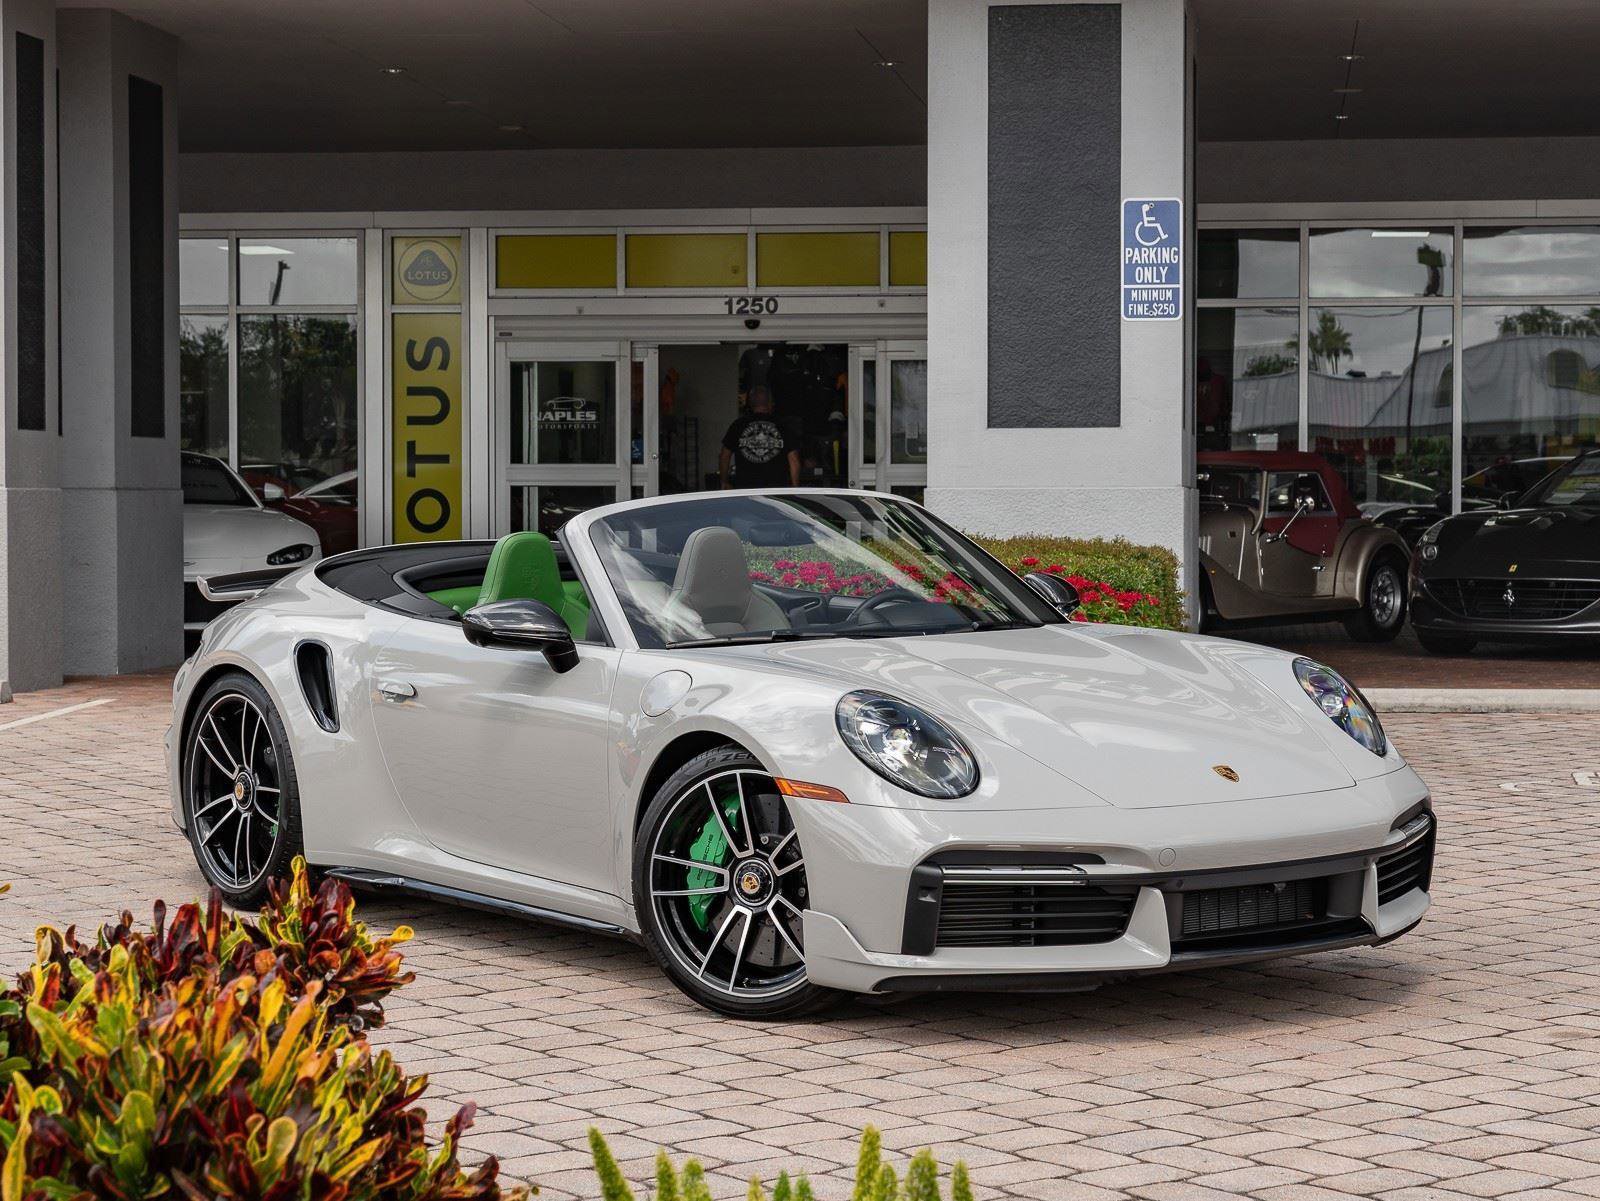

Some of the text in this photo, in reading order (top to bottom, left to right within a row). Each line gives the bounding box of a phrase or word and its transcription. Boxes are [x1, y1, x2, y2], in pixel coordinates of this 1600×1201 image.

[1125, 247, 1179, 264] PARKING
[407, 271, 449, 281] LOTUS
[1135, 266, 1168, 283] ONLY
[1131, 289, 1173, 301] MINIMUM
[724, 296, 779, 315] 1250
[1128, 302, 1175, 317] FINE $250
[405, 336, 451, 534] OTUS
[697, 834, 713, 880] POSCHE
